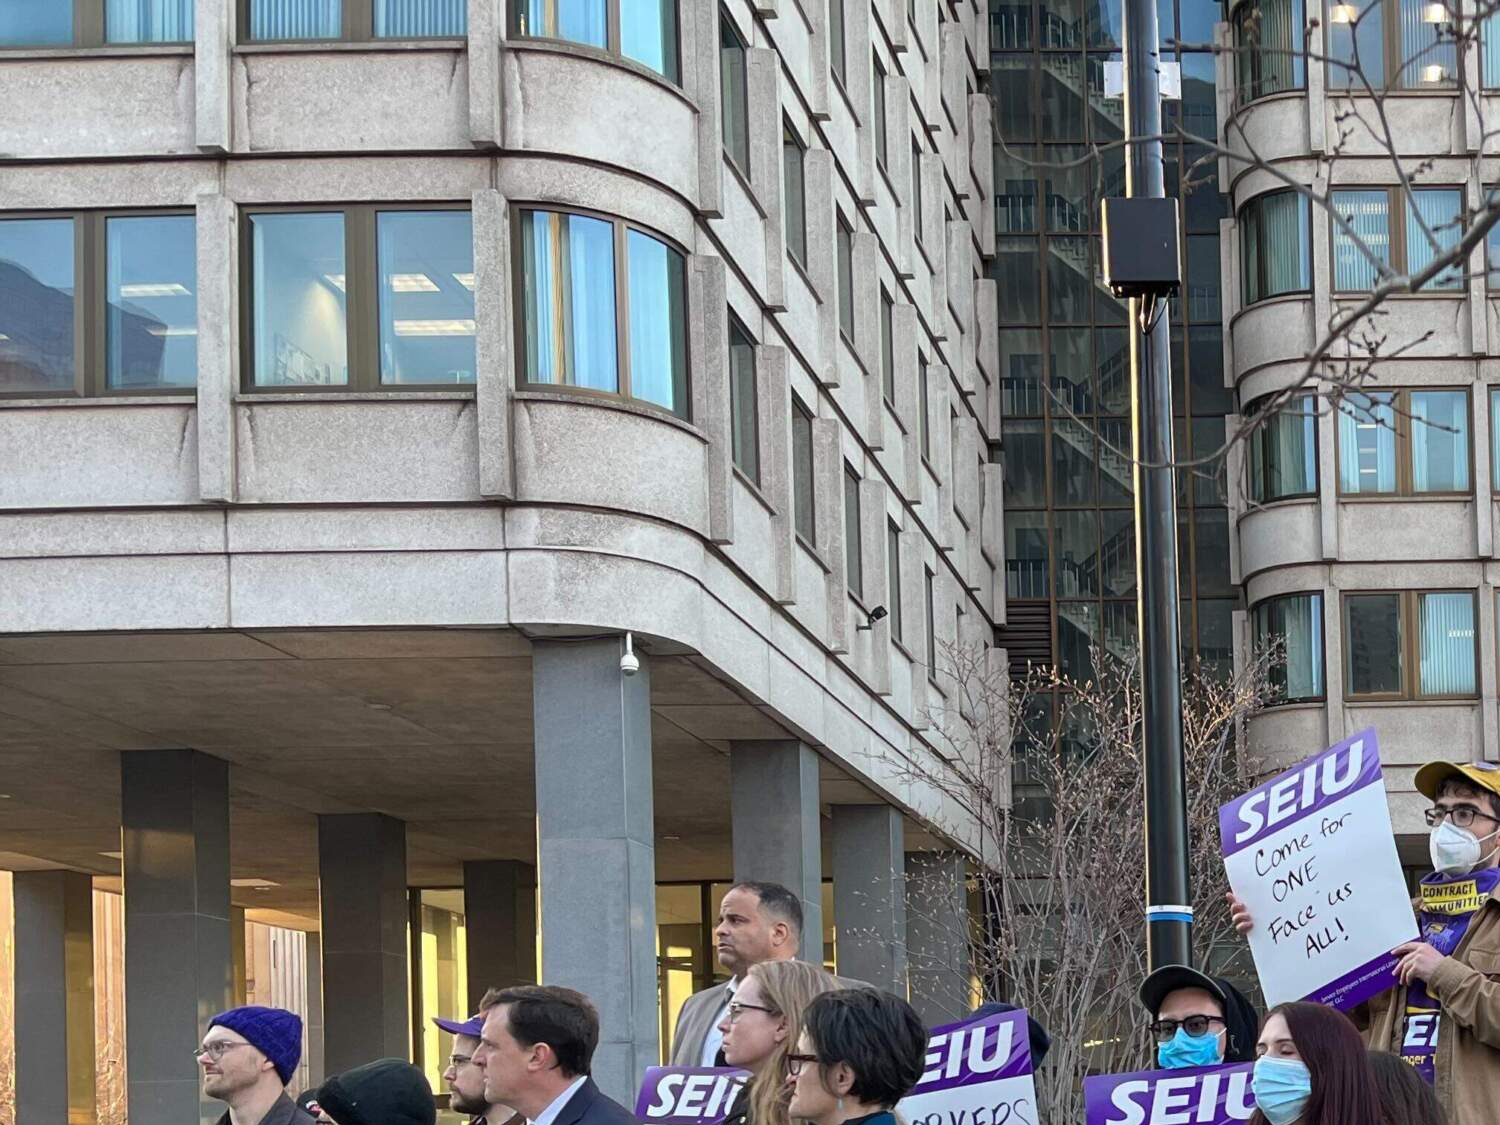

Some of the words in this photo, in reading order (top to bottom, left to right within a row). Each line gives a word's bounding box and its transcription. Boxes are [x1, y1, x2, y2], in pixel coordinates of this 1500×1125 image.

[1235, 740, 1363, 844] SEIU
[1320, 813, 1352, 837] for
[1272, 857, 1319, 902] ONE
[1423, 883, 1473, 897] CONTRACT
[1268, 908, 1317, 944] Face
[1328, 882, 1352, 906] us
[1304, 917, 1349, 959] ALL!
[918, 1020, 1014, 1085] EIU
